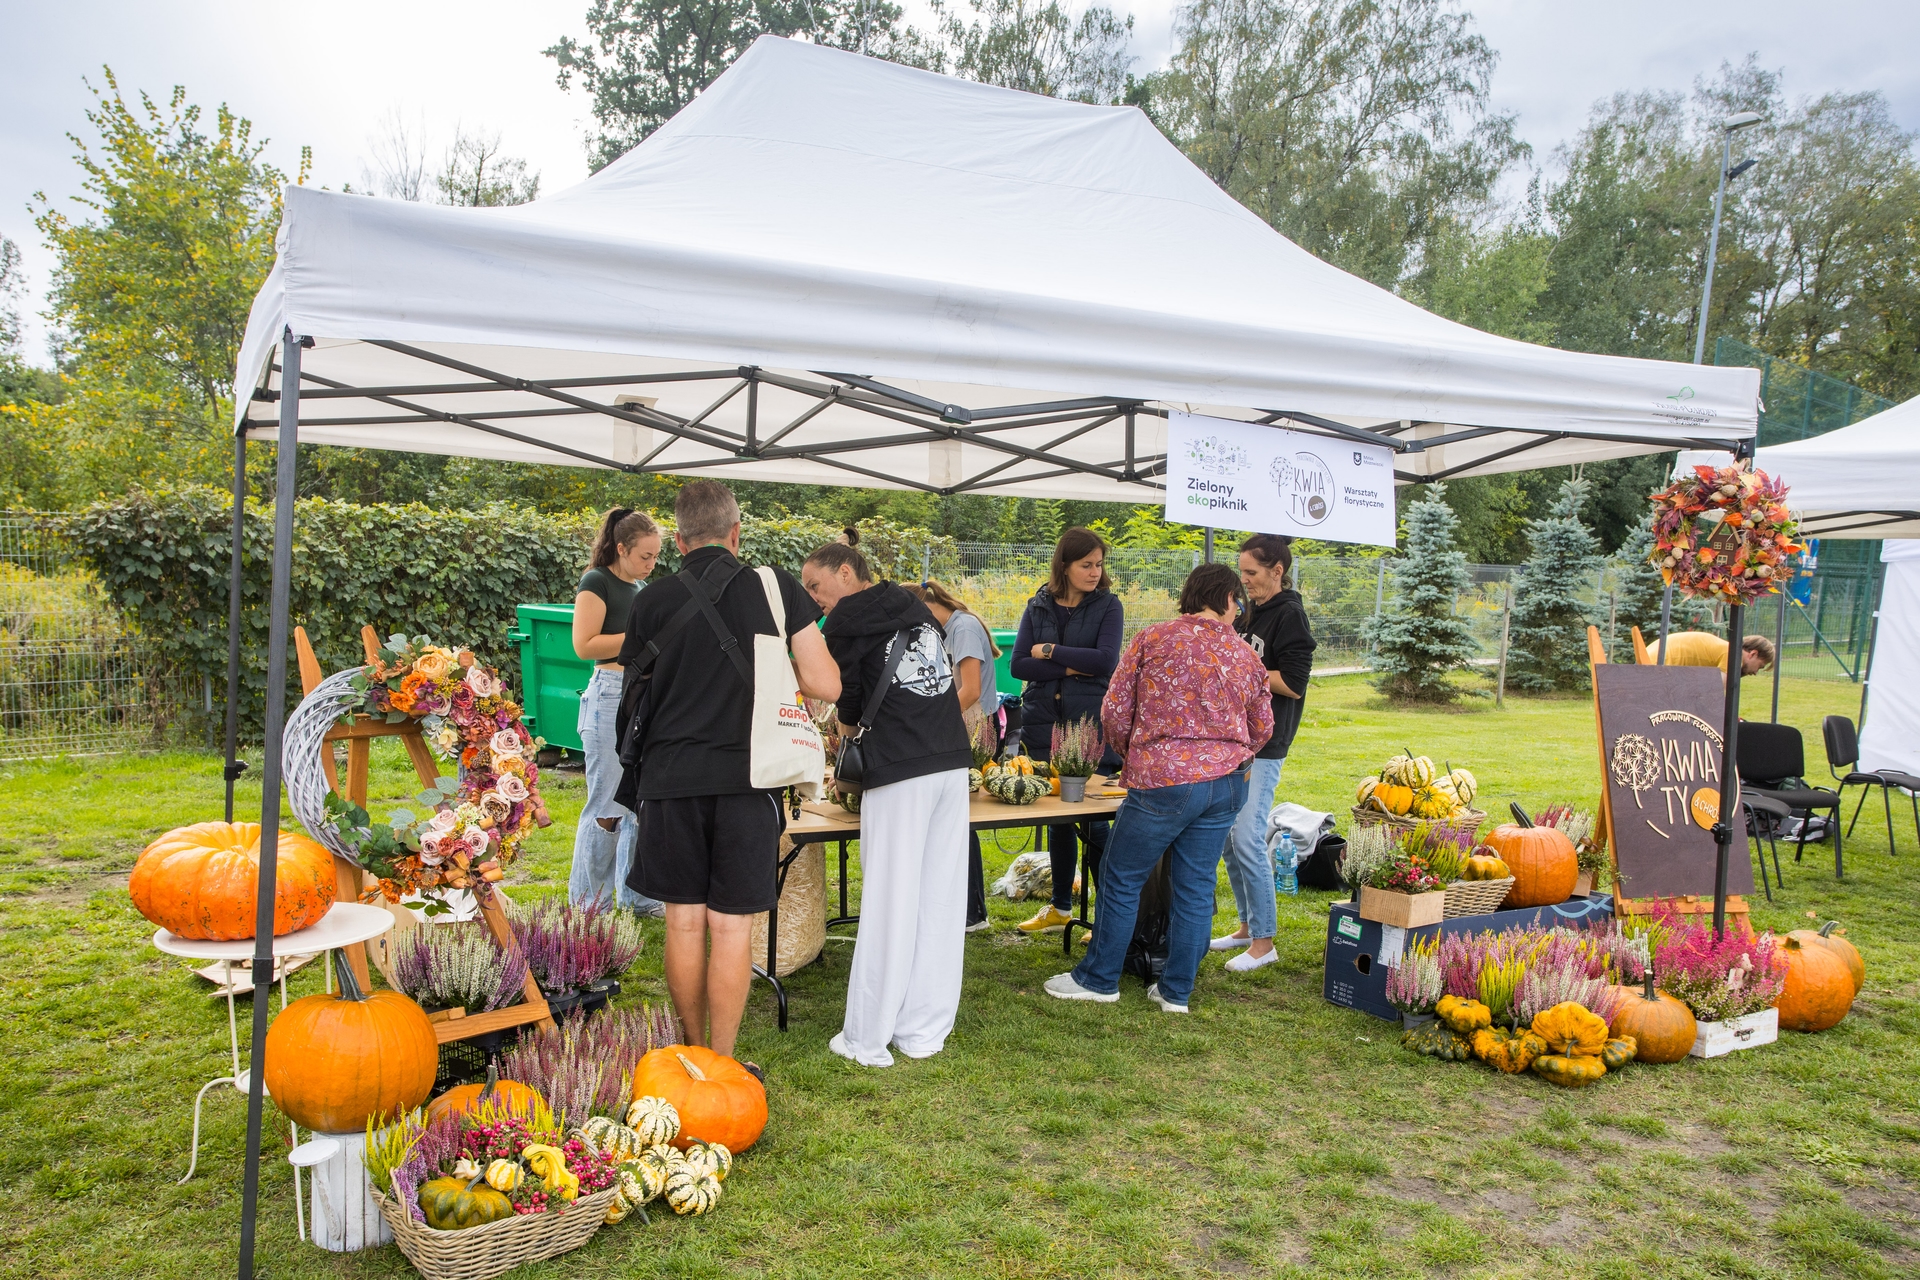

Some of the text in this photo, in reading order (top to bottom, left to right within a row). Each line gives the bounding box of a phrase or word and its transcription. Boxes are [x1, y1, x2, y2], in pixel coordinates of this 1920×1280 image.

[1187, 477, 1234, 497] Zielony
[1293, 467, 1325, 495] KWIA
[1343, 486, 1378, 498] Warsztaty
[1187, 493, 1248, 512] ekopiknik
[1290, 493, 1307, 518] TY
[1344, 496, 1385, 509] florystyczne
[777, 720, 800, 728] MARKET
[779, 707, 808, 723] OGRD
[1651, 713, 1724, 753] PRACOWNIA FLORYSTY
[1661, 738, 1719, 783] KWIA
[1660, 785, 1690, 826] TY
[1700, 800, 1720, 821] CHRÓ
